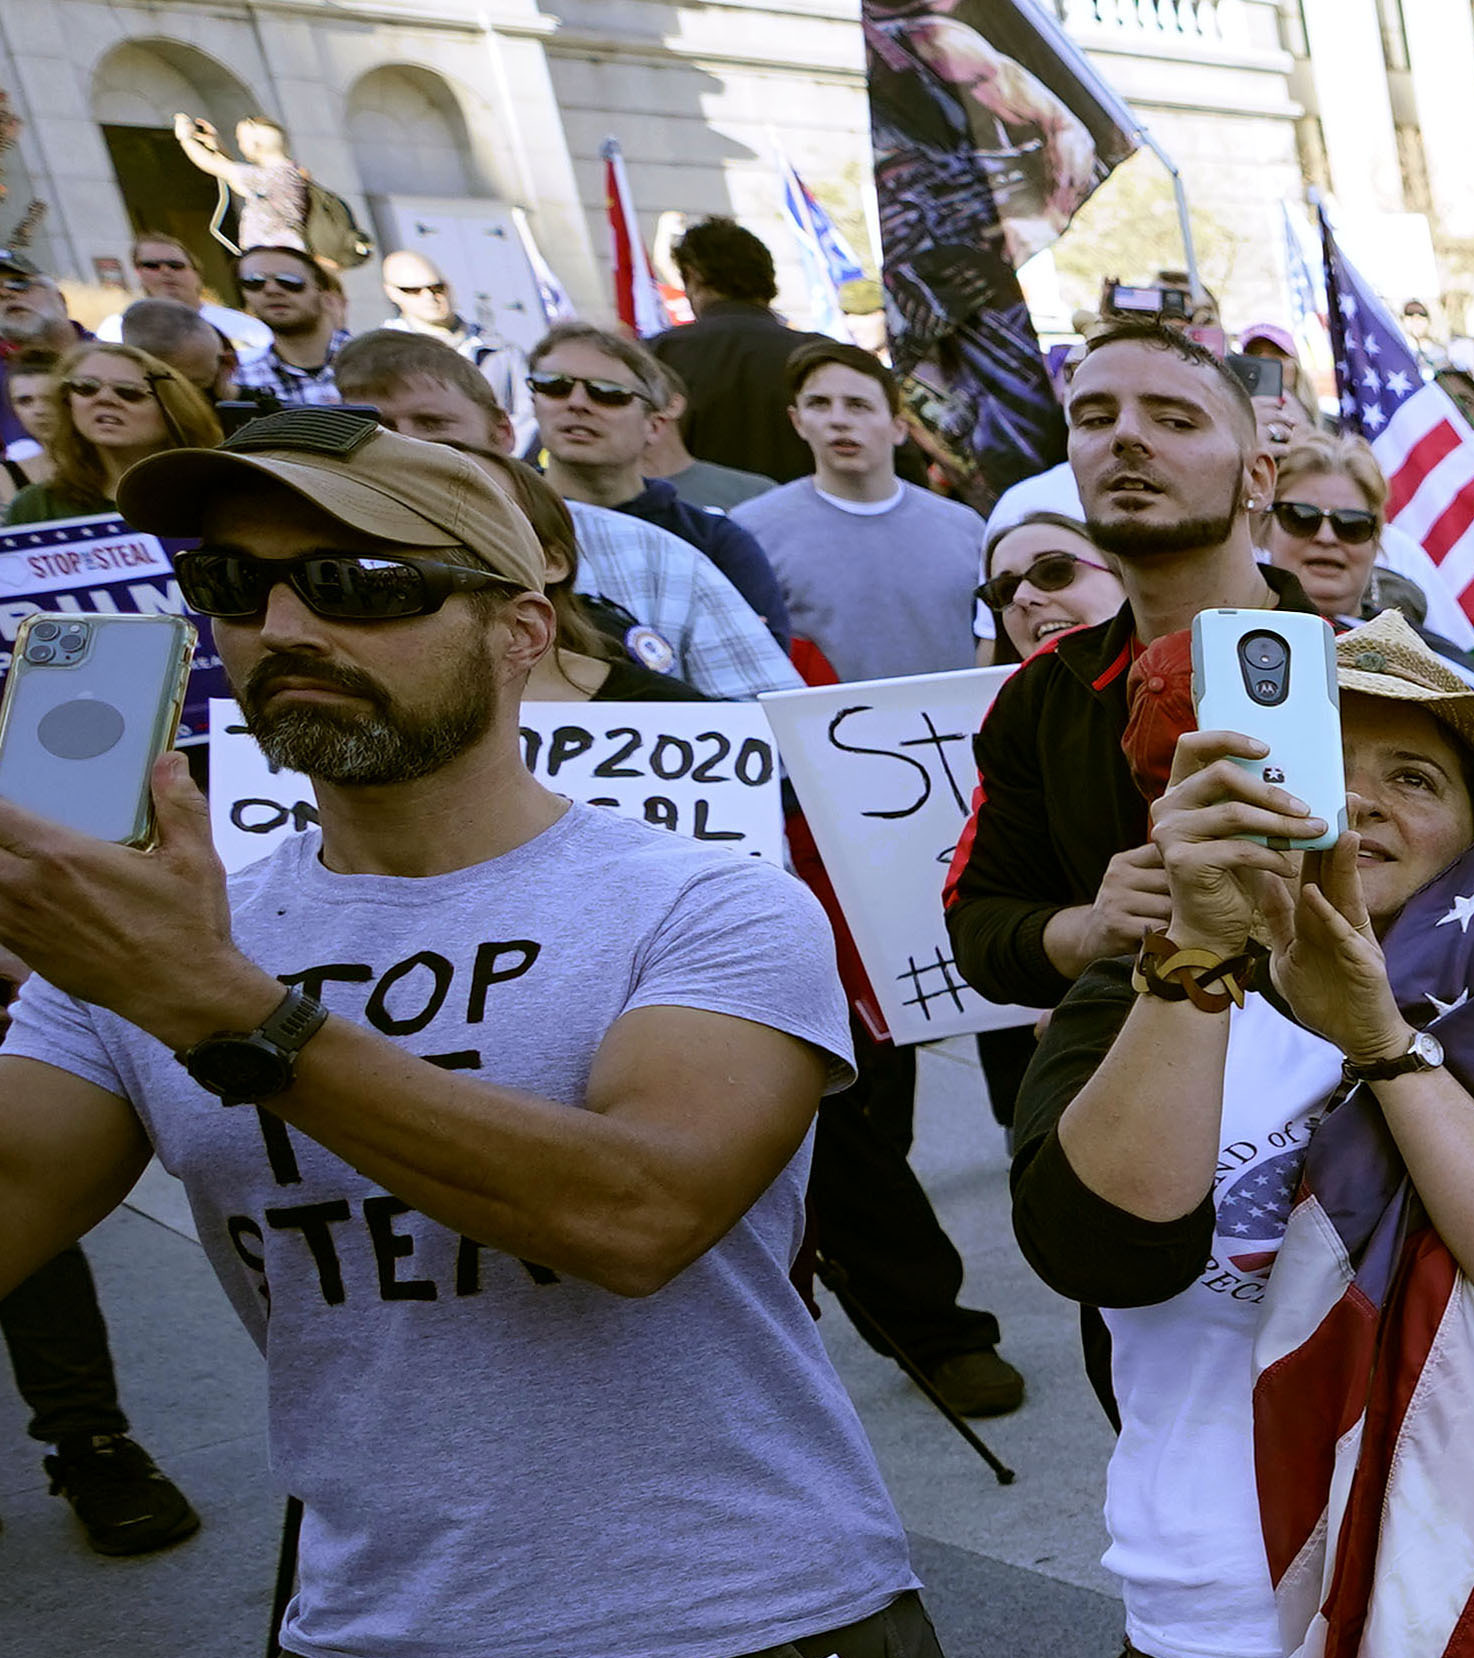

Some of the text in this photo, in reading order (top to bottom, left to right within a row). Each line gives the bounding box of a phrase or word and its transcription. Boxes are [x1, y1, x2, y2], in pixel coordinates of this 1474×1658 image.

[28, 551, 81, 579] STOP
[93, 542, 159, 570] STEAL
[1268, 1121, 1303, 1149] of
